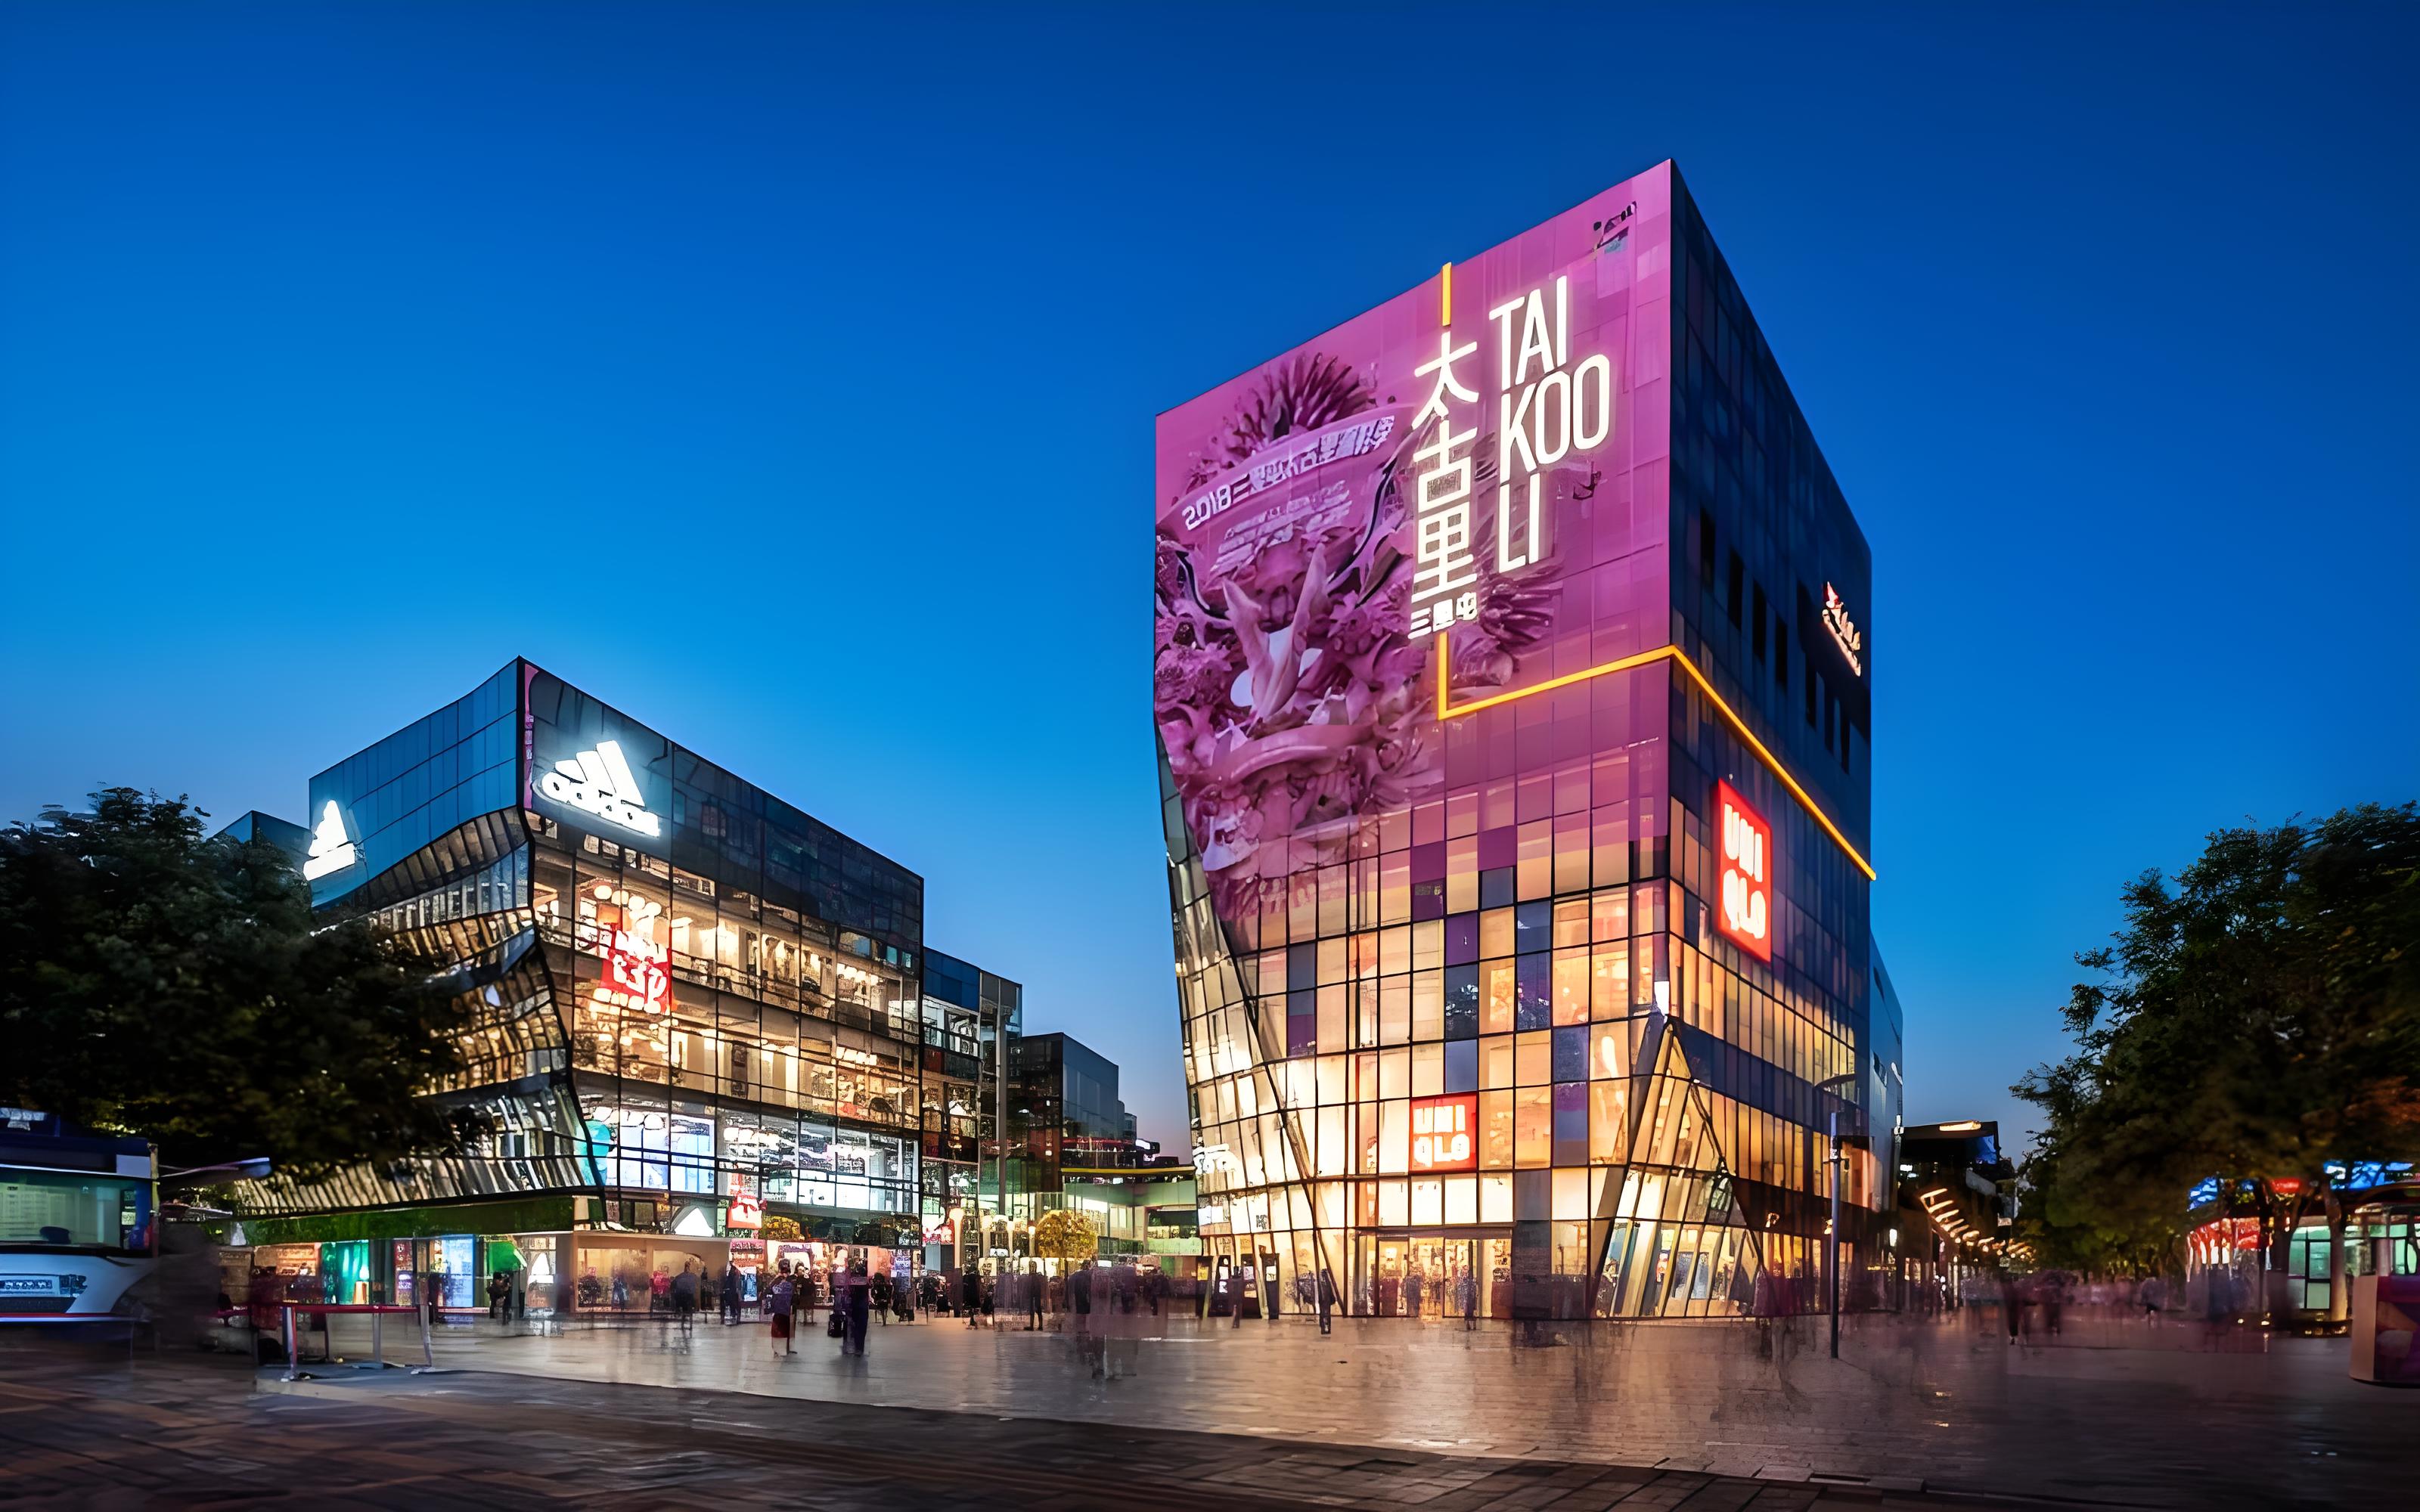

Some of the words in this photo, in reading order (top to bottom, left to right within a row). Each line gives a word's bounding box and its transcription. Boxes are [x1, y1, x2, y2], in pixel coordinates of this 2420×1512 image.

[1489, 275, 1568, 392] TAI
[1411, 330, 1479, 603] 太古里
[1500, 354, 1611, 486] KOO
[1498, 472, 1540, 575] LI
